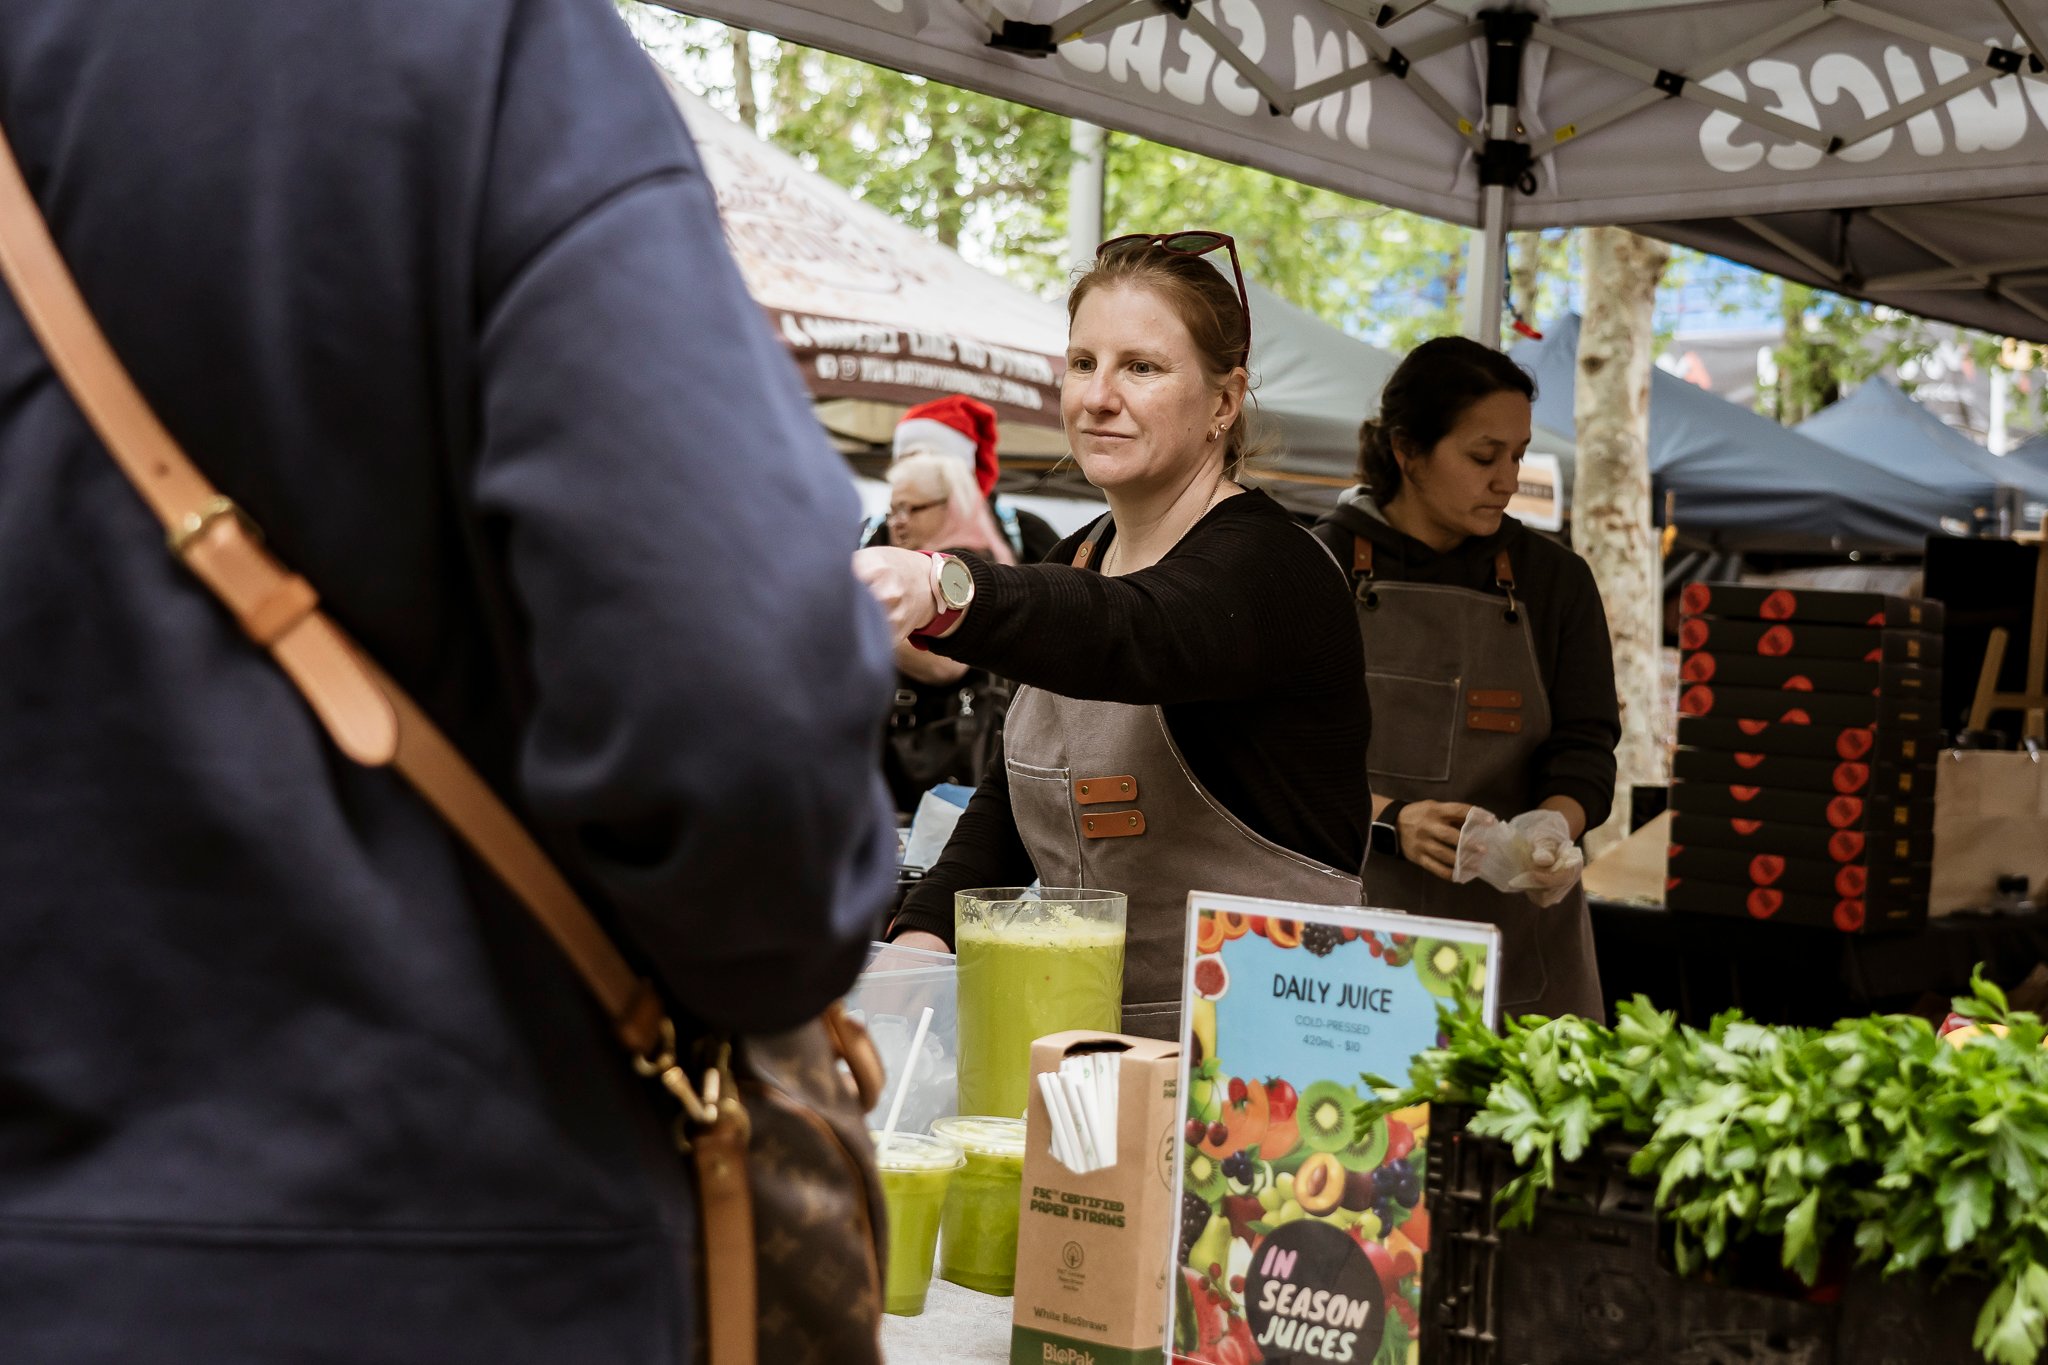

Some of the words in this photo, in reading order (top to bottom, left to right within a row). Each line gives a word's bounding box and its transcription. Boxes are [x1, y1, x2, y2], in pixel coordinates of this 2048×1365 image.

[1272, 973, 1331, 1004] DAILY
[1336, 982, 1393, 1014] JUICE
[1294, 1014, 1371, 1035] COLD-PRESSED
[1344, 1039, 1361, 1052] $10
[1029, 1199, 1070, 1218] PAPER
[1071, 1206, 1126, 1228] STRAWS
[1060, 1191, 1125, 1212] CERTIFIED
[1260, 1244, 1298, 1279] IN
[1033, 1305, 1061, 1321] White
[1258, 1279, 1370, 1329] SEASON
[1257, 1315, 1358, 1363] JUICES
[1042, 1342, 1096, 1365] BioPak
